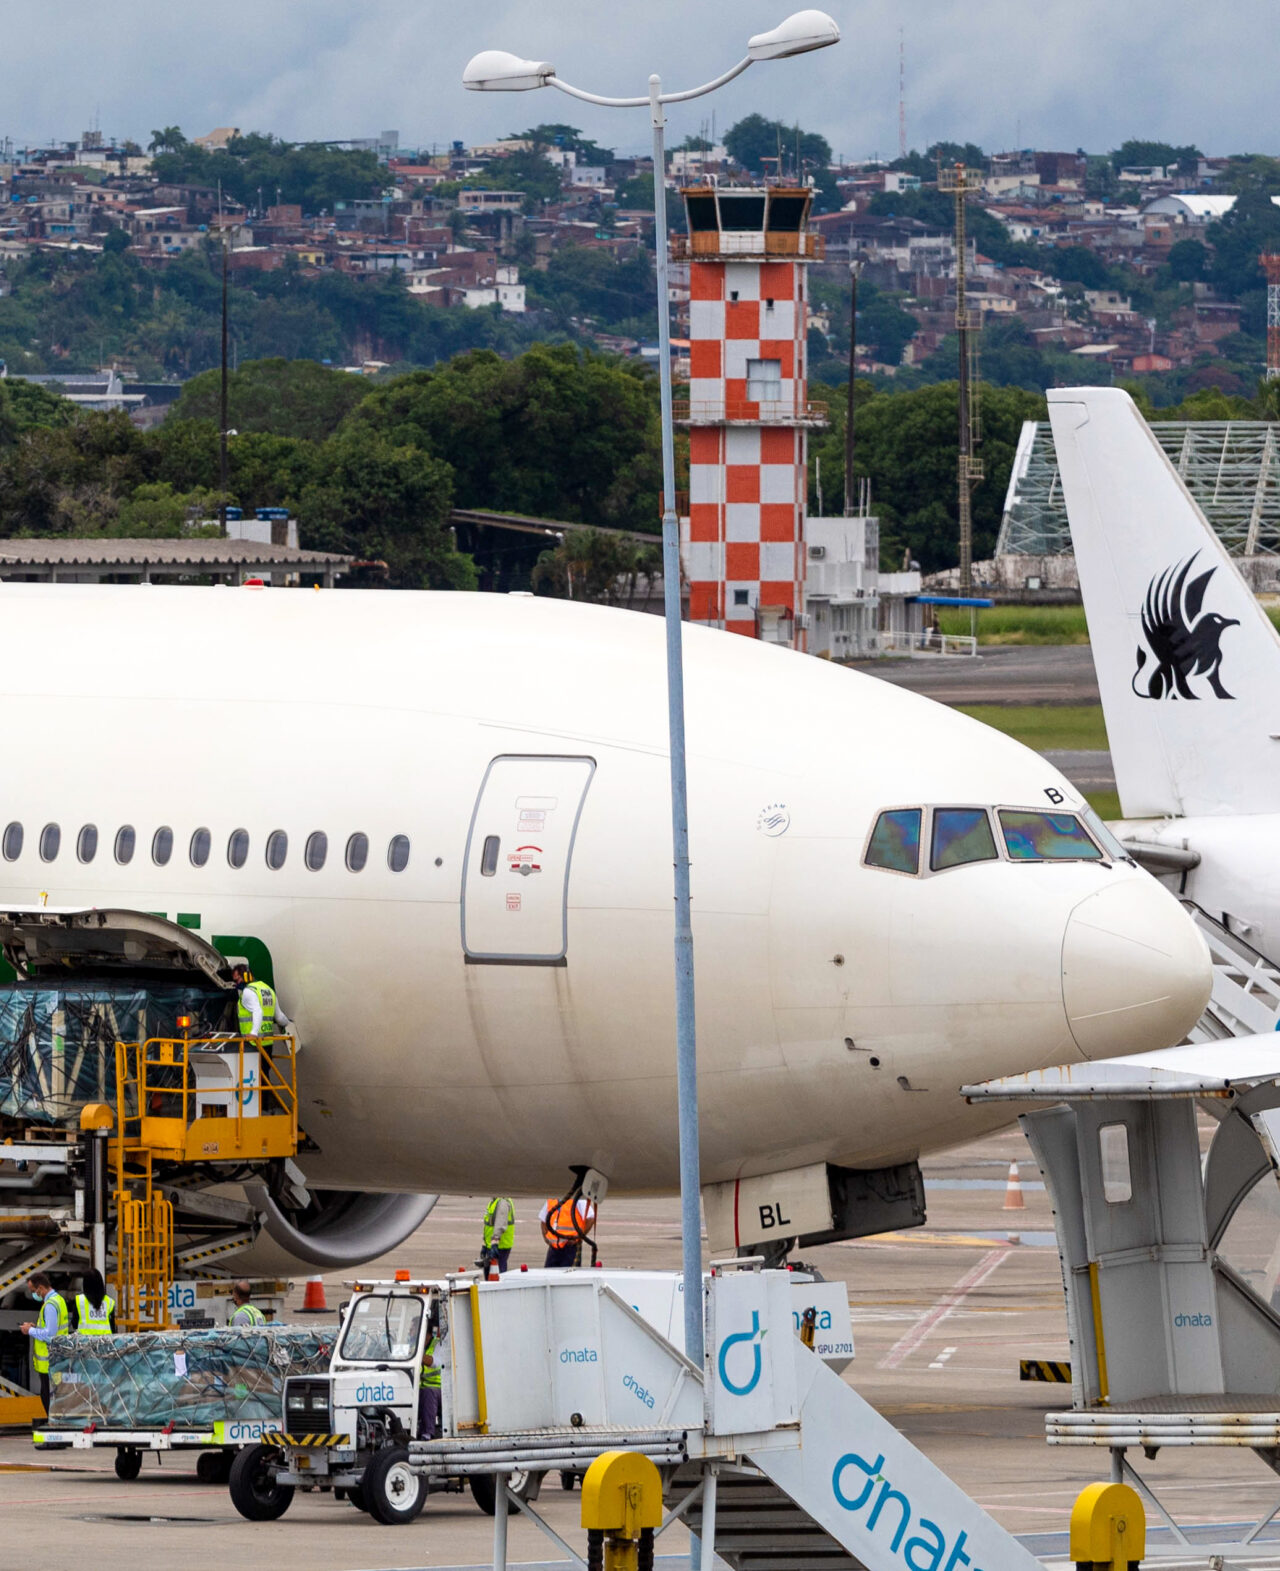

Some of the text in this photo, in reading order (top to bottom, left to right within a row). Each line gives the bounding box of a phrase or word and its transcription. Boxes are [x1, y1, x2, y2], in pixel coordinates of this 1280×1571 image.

[1043, 787, 1065, 805] B
[759, 1202, 791, 1229] BL
[1174, 1312, 1212, 1327] dnata
[560, 1348, 598, 1363] dnata
[817, 1343, 853, 1354] GPU 2701
[356, 1381, 394, 1403] dnata
[622, 1374, 655, 1409] dnata
[832, 1453, 985, 1571] dnat
